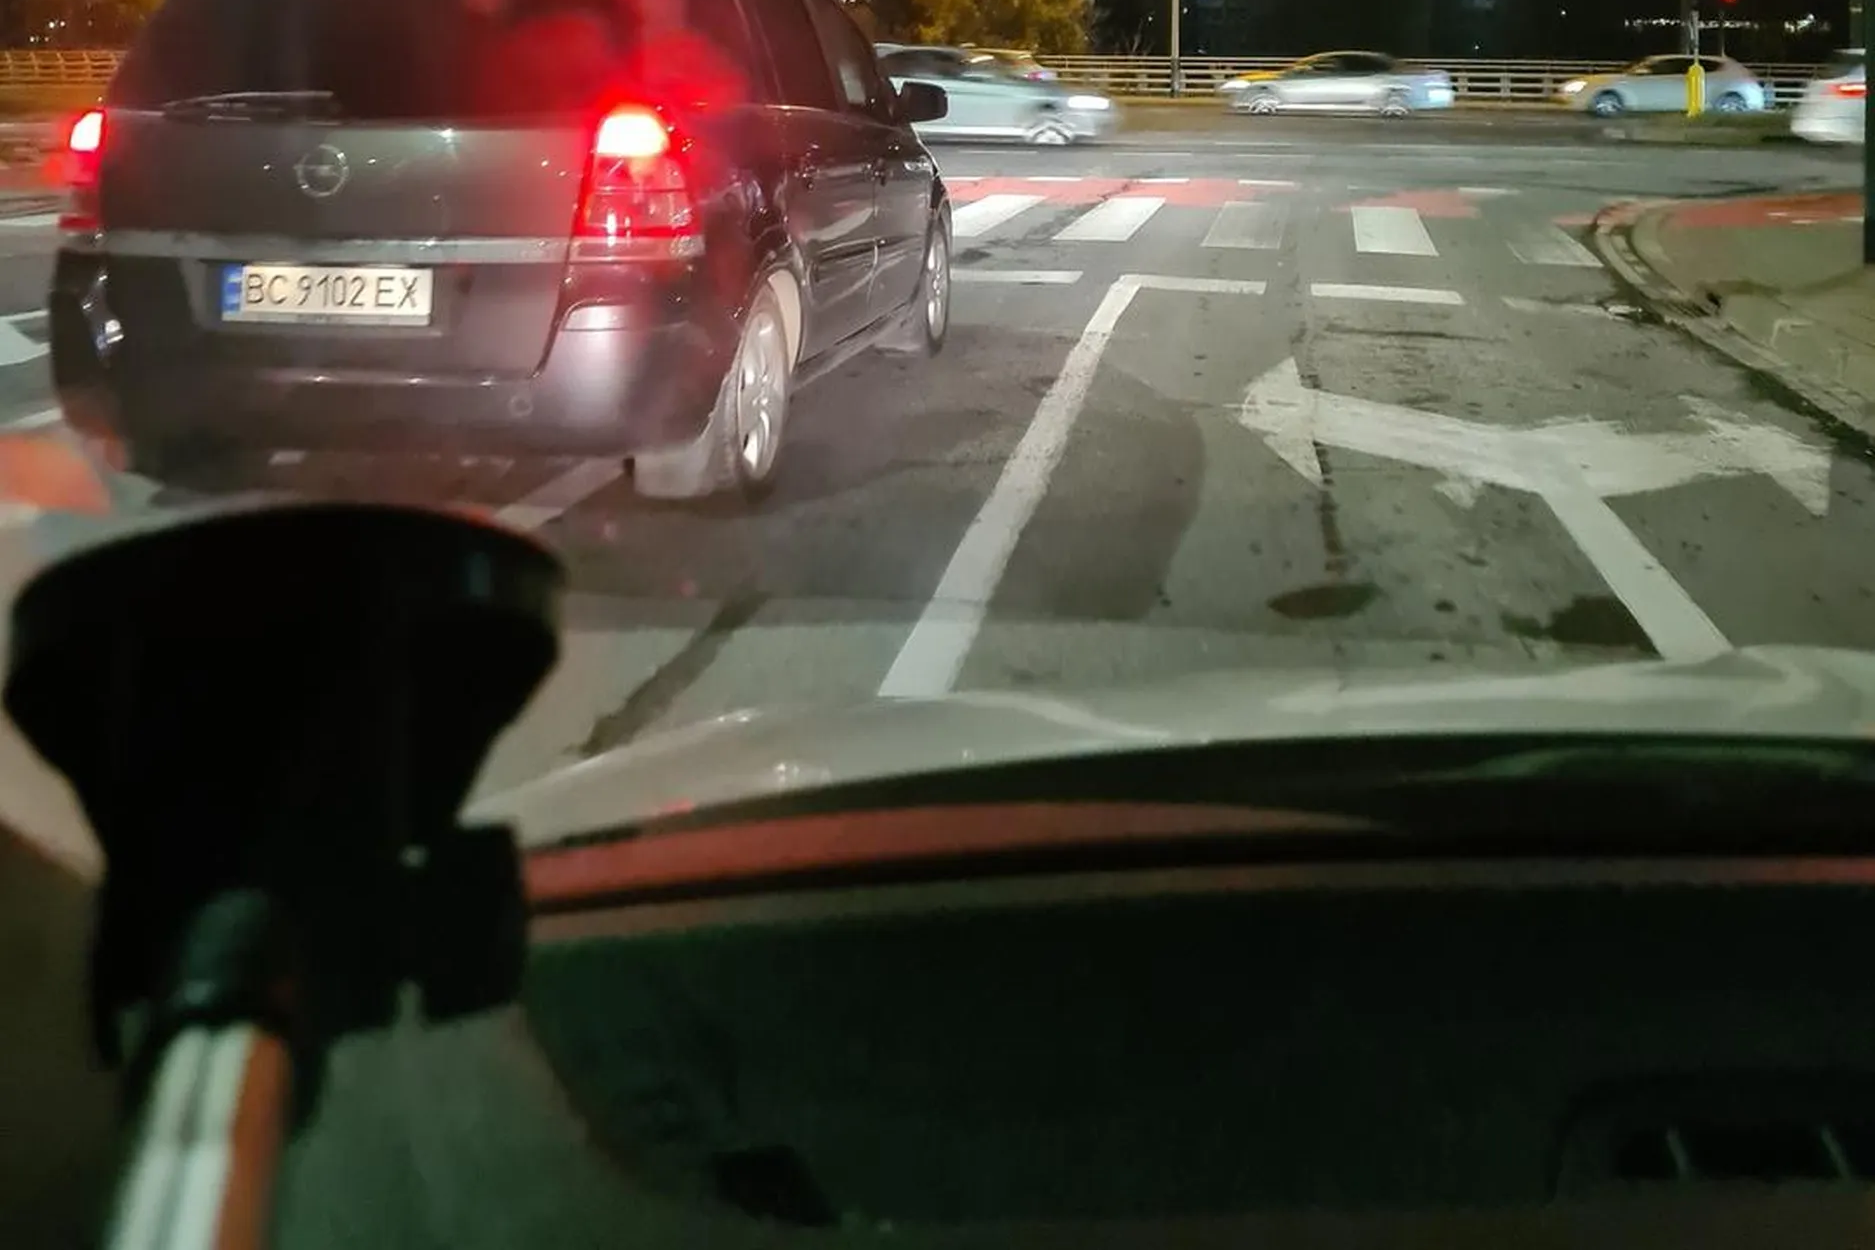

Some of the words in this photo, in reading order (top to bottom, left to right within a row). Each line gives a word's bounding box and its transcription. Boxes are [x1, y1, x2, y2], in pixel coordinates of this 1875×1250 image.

[246, 273, 287, 305] BC
[297, 274, 365, 307] 9102
[375, 276, 419, 308] EX
